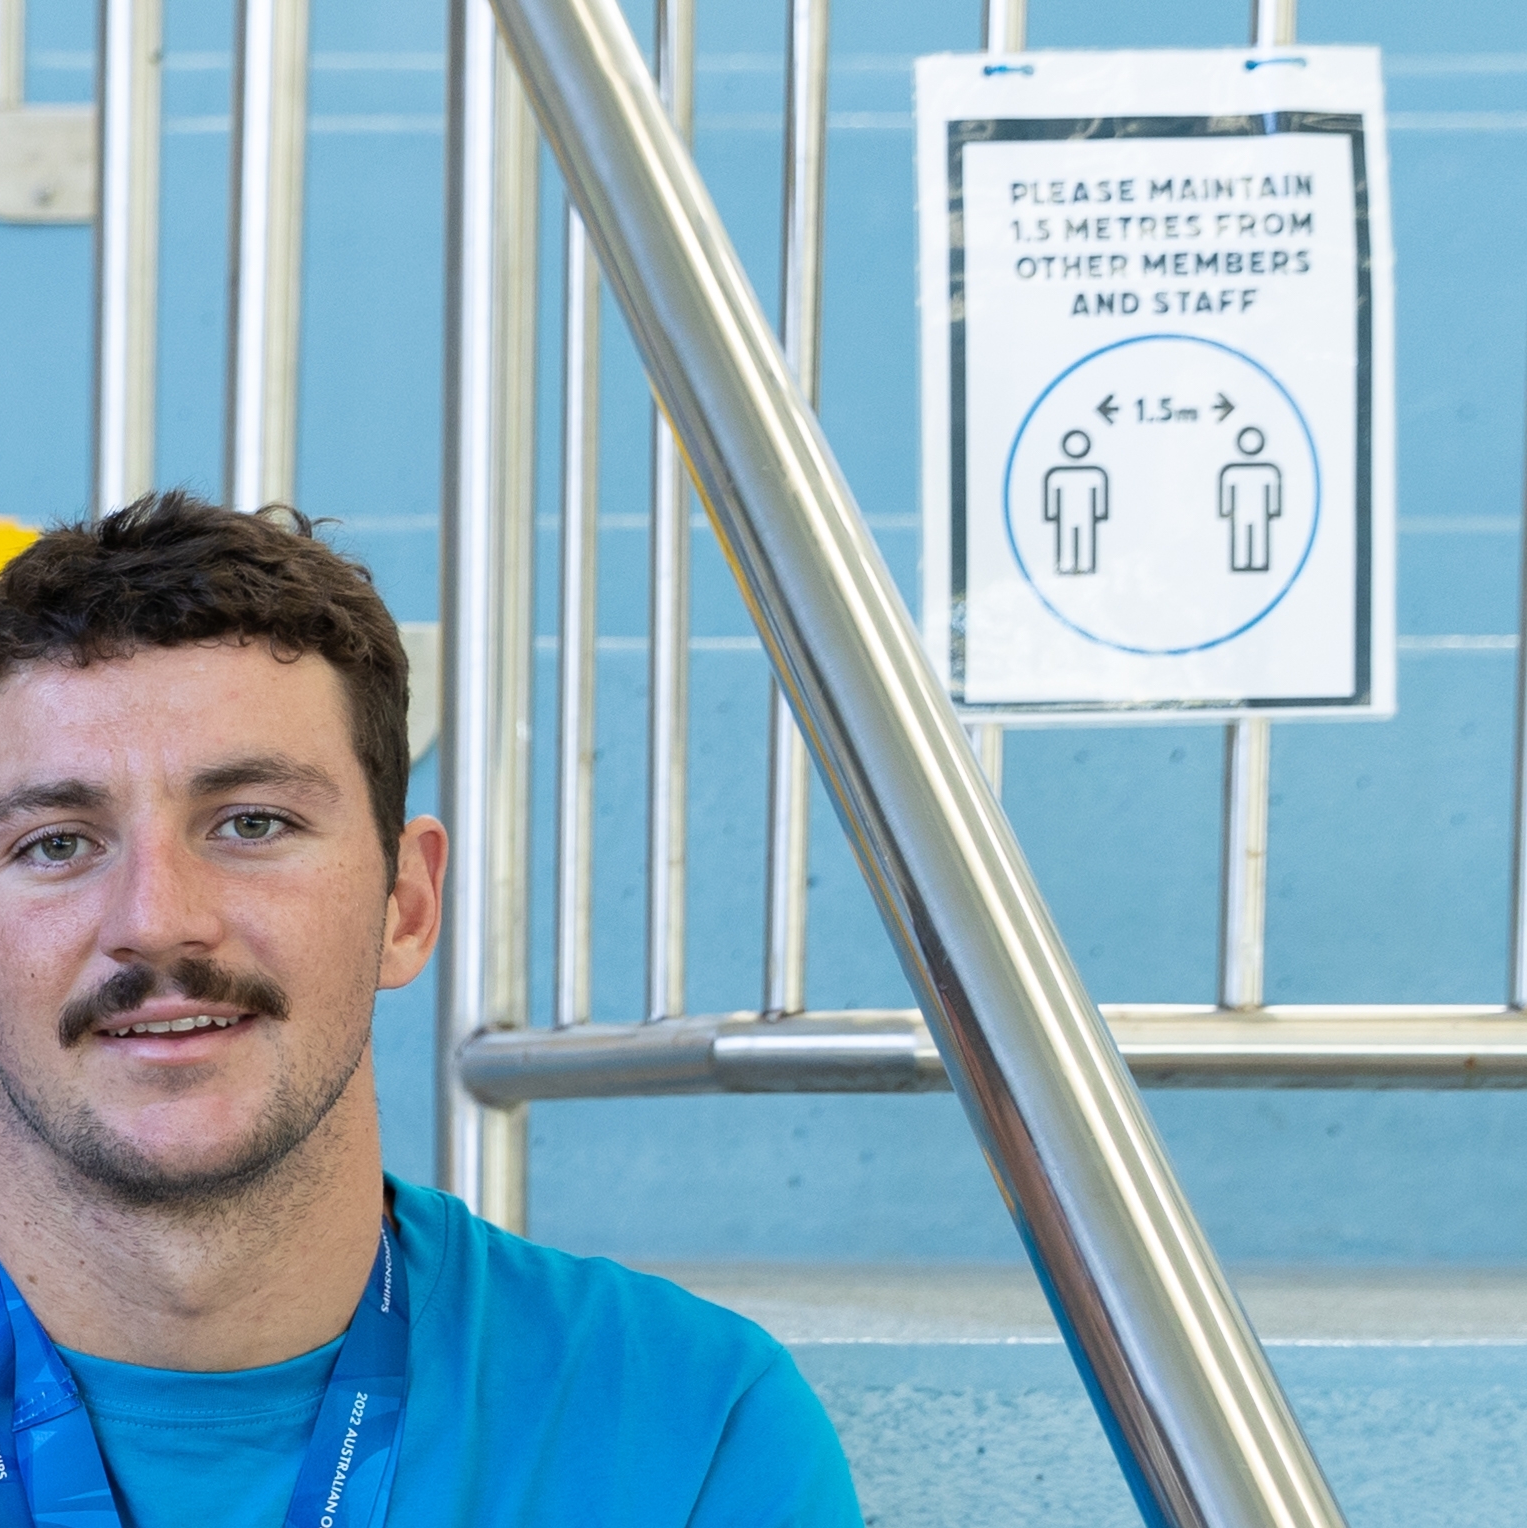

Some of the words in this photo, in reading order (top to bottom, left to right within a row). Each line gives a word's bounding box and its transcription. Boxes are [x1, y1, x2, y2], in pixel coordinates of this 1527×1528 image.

[1010, 177, 1135, 205] PLEASE
[1148, 173, 1313, 201] MAINTAIN
[1012, 218, 1051, 242] 1.5
[1065, 215, 1202, 240] METRES
[1216, 211, 1315, 237] FROM
[1015, 255, 1128, 281] OTHER
[1141, 249, 1311, 275] MEMBERS
[1071, 292, 1139, 317] AND
[1153, 288, 1258, 315] STAFF
[1135, 397, 1199, 423] 1.5m
[348, 1390, 369, 1426] 2022
[325, 1427, 359, 1515] AUSTRALIAN
